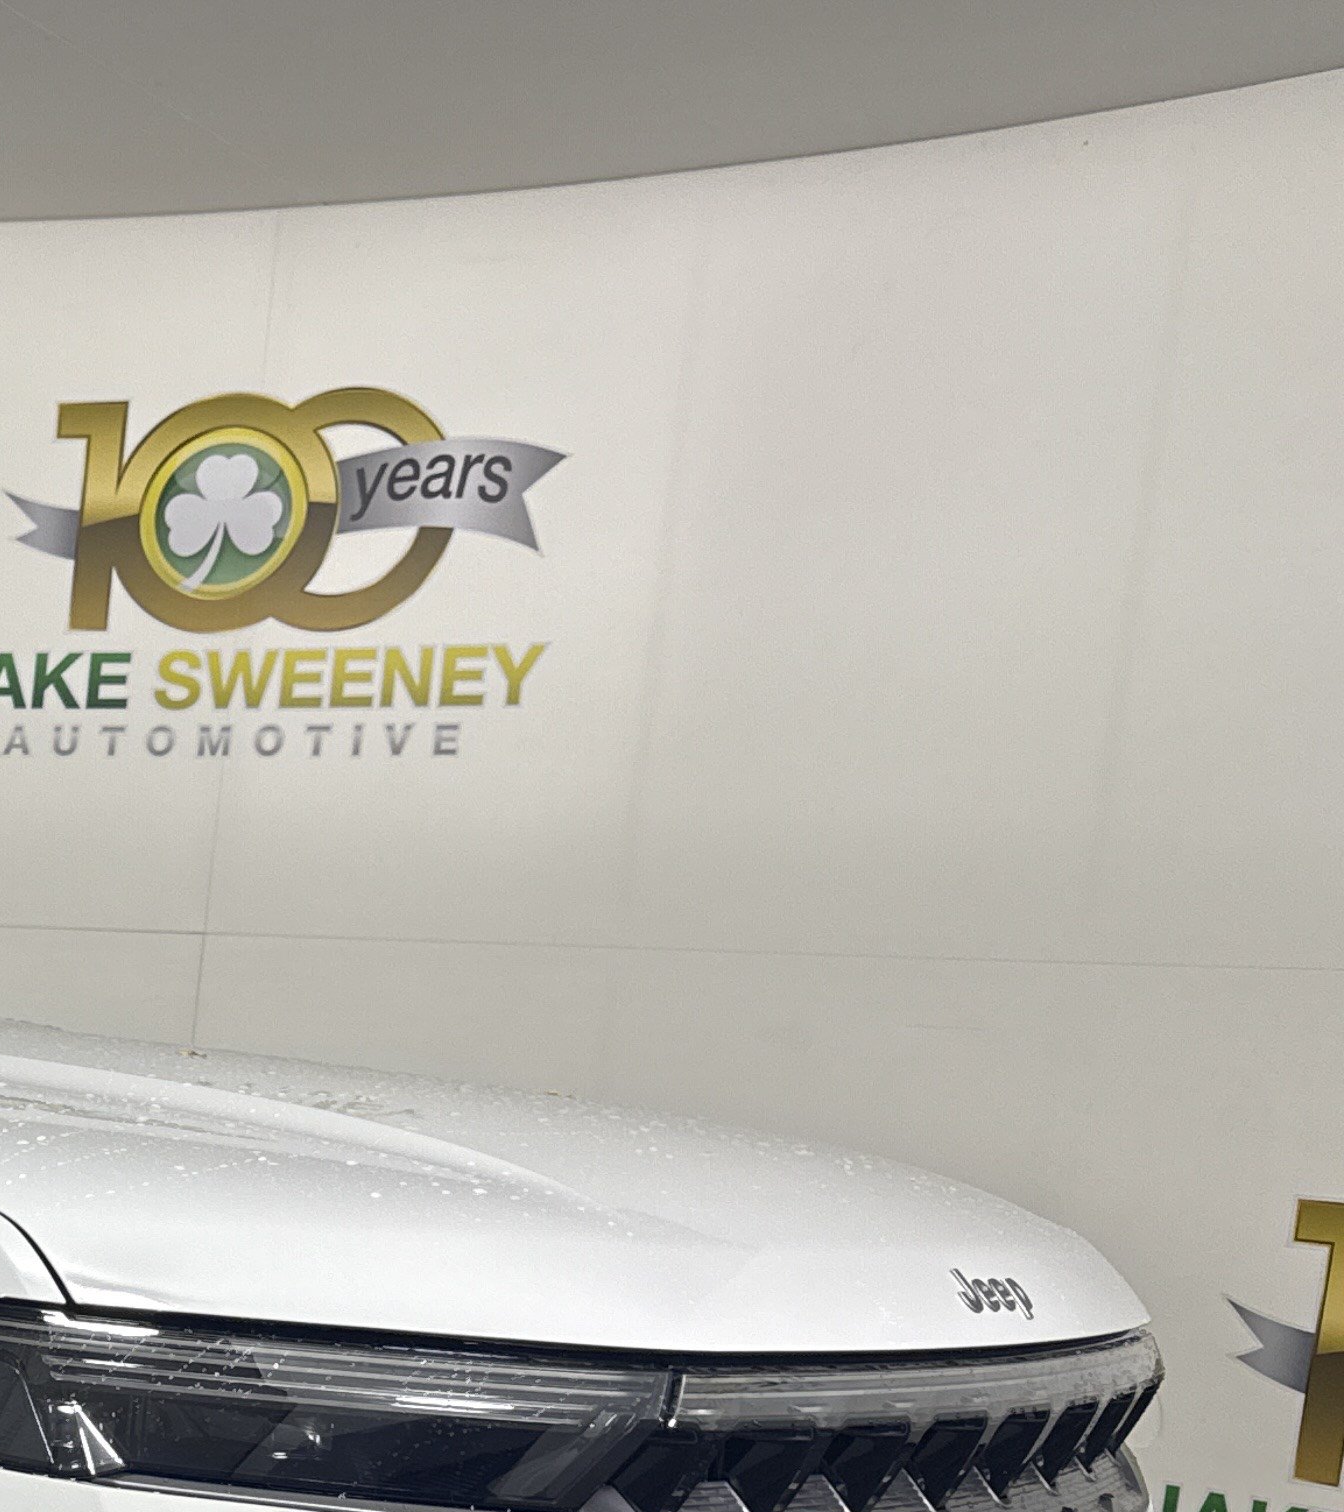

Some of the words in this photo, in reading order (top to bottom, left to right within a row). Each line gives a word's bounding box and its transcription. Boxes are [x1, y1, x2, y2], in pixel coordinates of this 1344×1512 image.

[56, 387, 455, 632] 100
[349, 452, 513, 521] years
[153, 642, 550, 709] SWEENEY
[2, 722, 462, 757] AUTOMOTIVE
[949, 1268, 1034, 1320] Jeep
